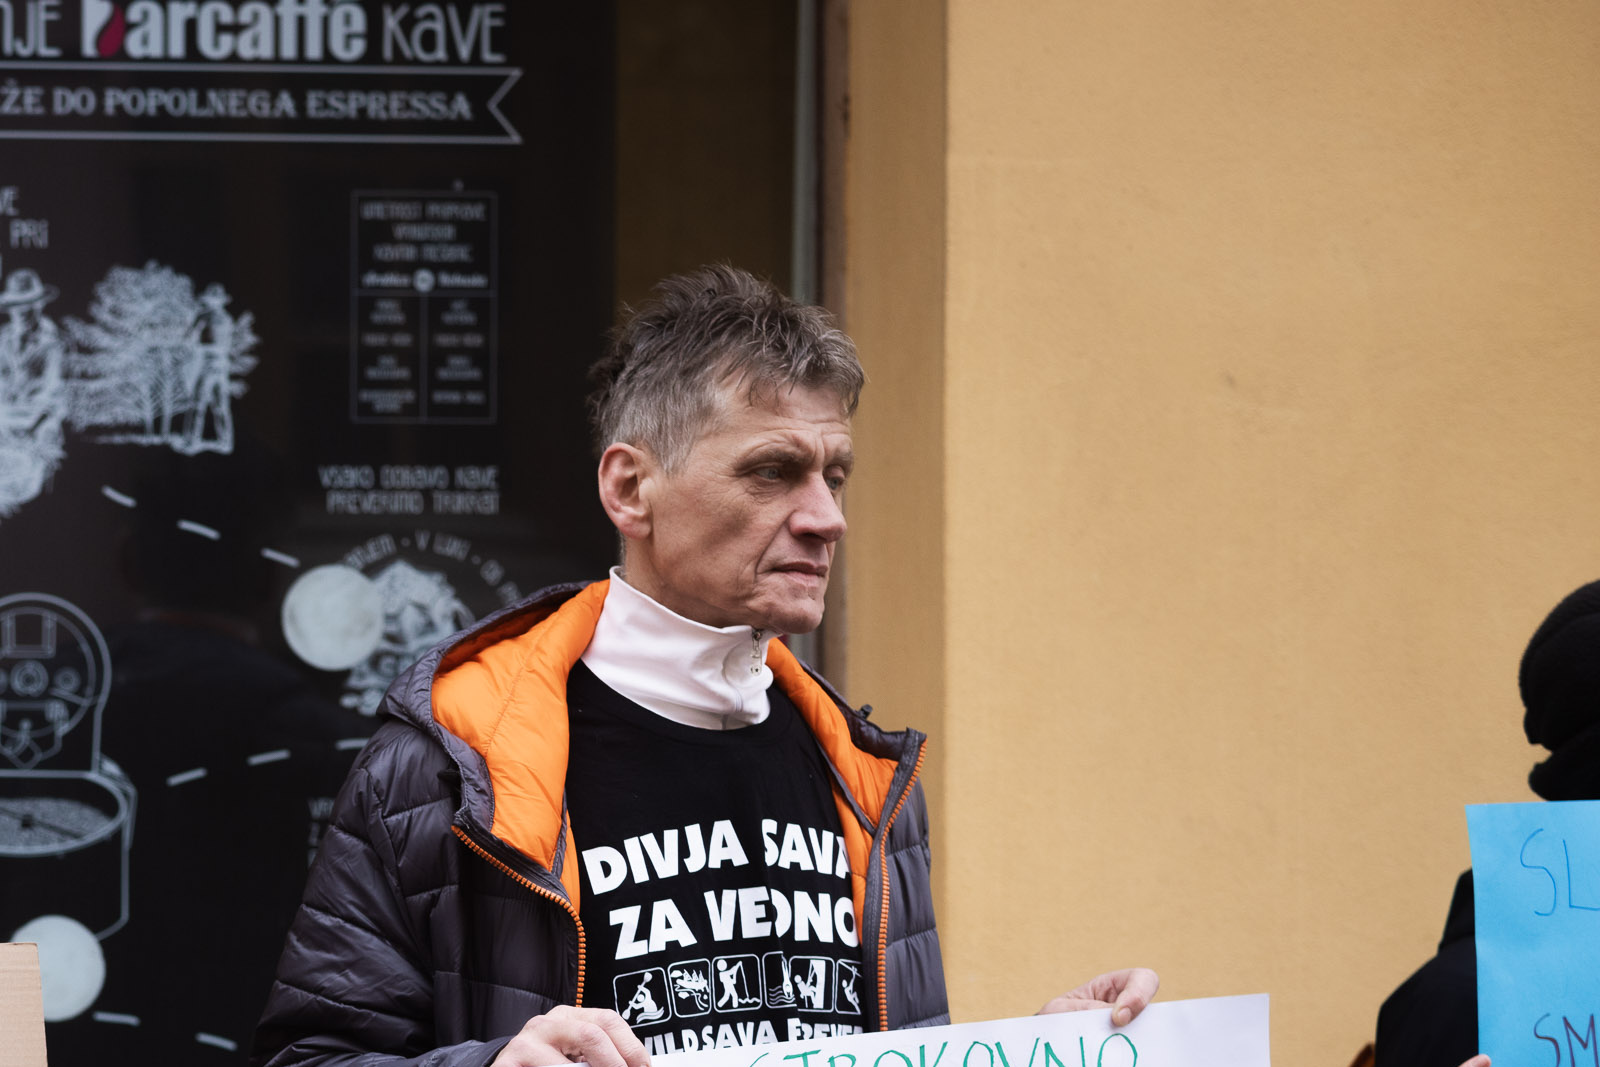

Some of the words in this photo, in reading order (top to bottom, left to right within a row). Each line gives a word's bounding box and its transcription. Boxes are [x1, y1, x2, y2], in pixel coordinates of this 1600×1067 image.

[52, 87, 96, 115] DO
[103, 88, 297, 118] POPOLNEGA
[305, 91, 472, 121] ESPRESSA
[582, 819, 748, 895] DIVJA
[609, 898, 698, 960] ZA
